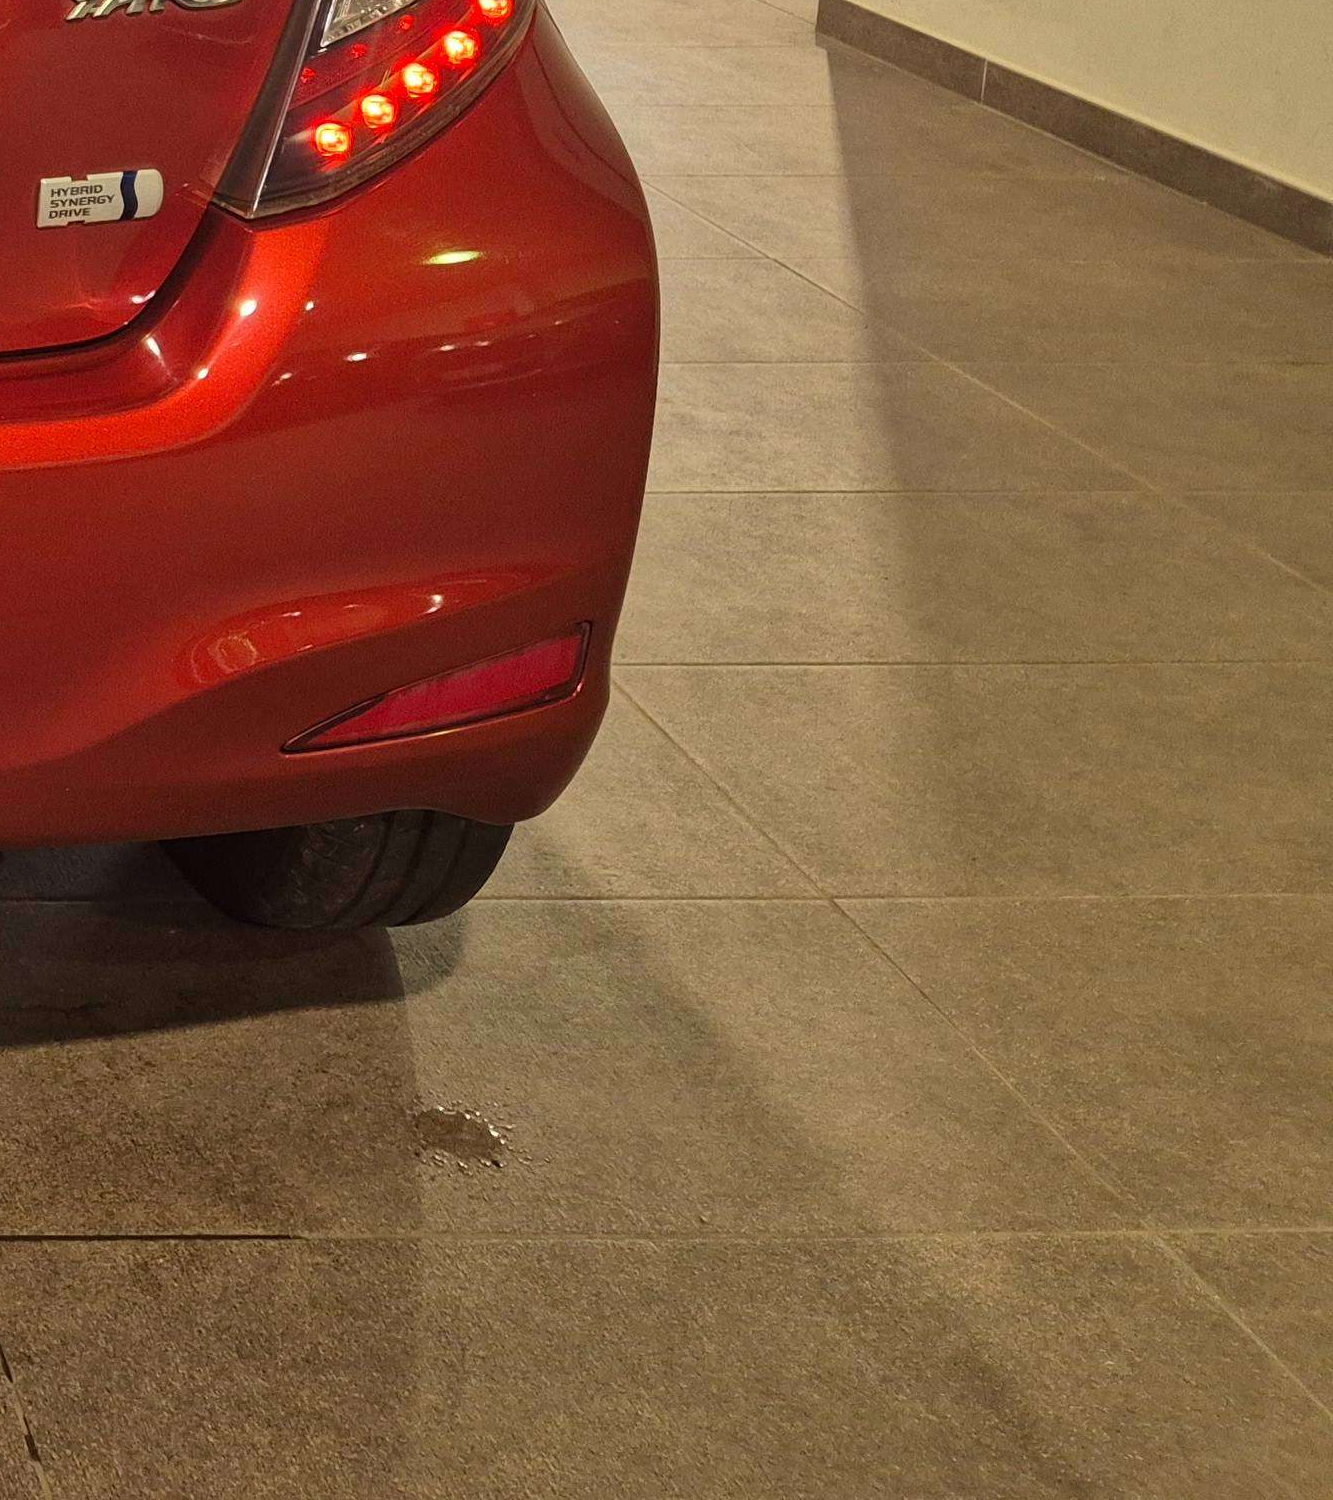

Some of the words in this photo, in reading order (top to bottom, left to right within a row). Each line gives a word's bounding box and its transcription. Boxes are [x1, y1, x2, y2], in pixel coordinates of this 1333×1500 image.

[50, 184, 103, 197] HYBRID
[49, 194, 115, 208] SYNERGY
[48, 208, 91, 219] DRIVE
